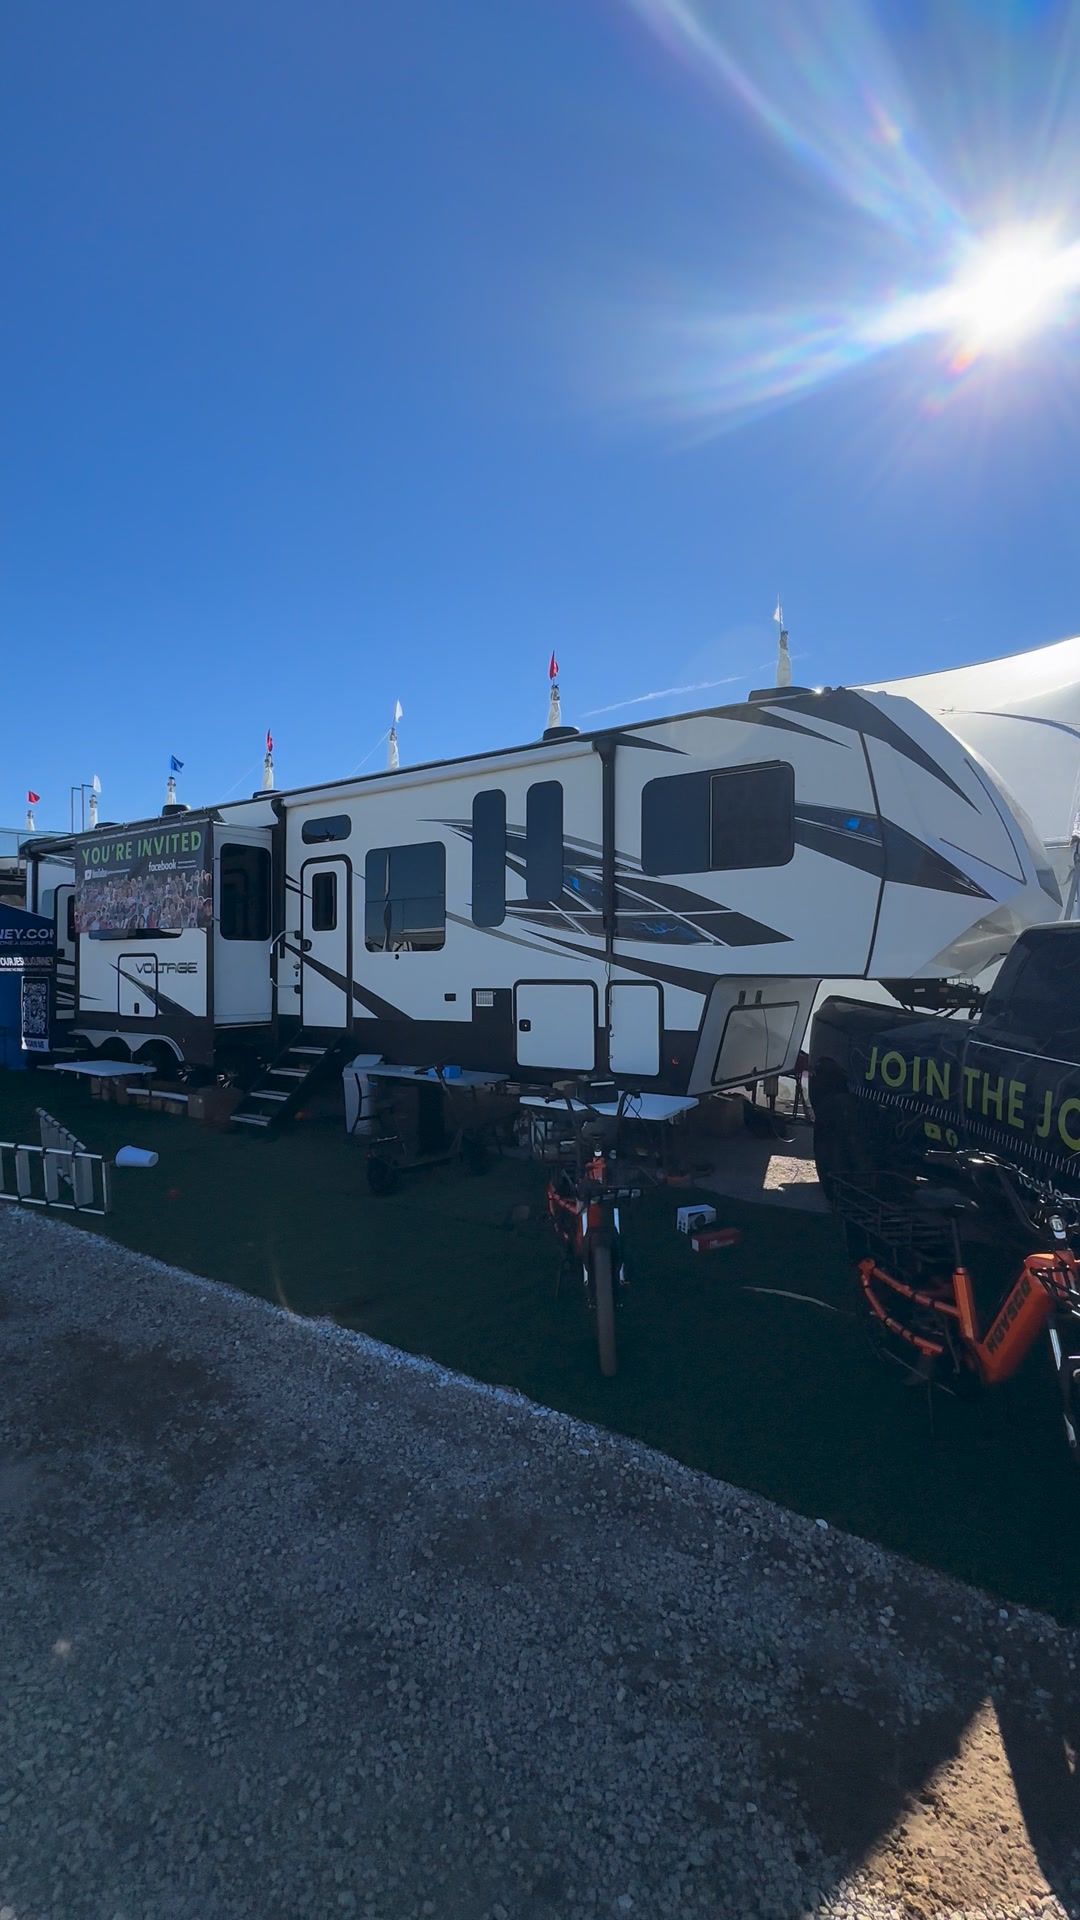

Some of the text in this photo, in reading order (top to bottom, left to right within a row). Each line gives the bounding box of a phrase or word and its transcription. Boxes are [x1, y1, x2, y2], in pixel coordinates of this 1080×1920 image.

[81, 830, 202, 866] YOU'RE INVITED
[148, 858, 177, 872] facebook
[135, 962, 198, 974] VOLTAGE
[864, 1046, 951, 1100] JOIN
[963, 1066, 1027, 1129] THE
